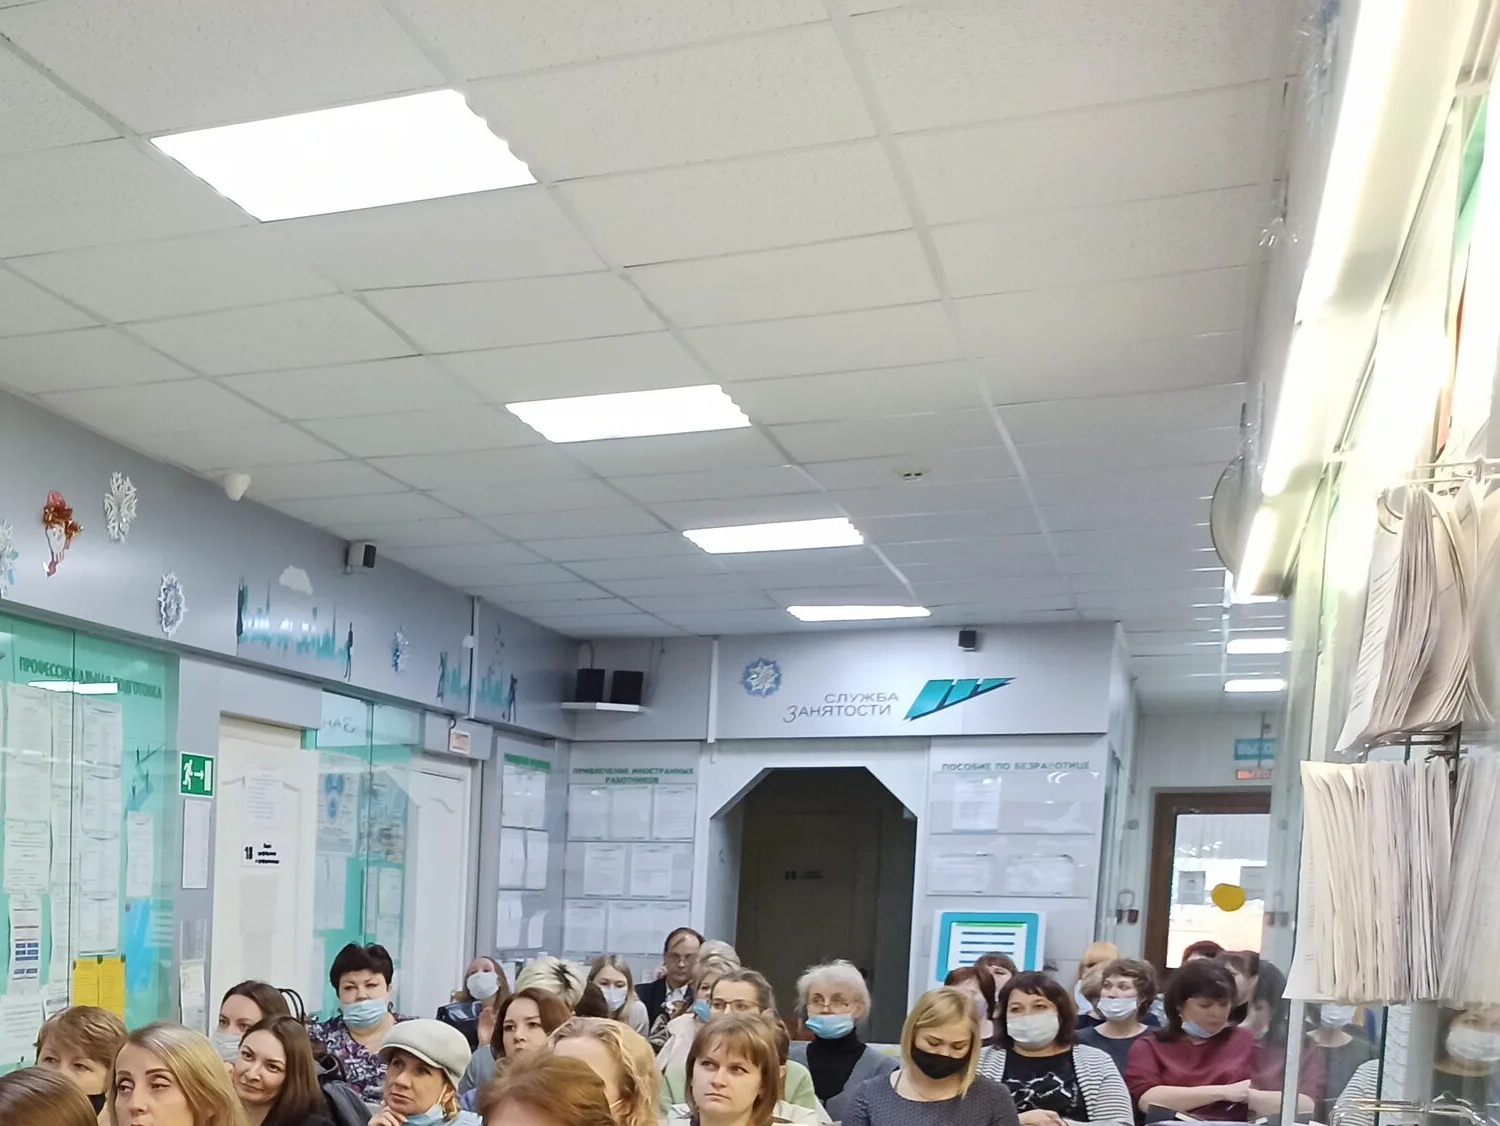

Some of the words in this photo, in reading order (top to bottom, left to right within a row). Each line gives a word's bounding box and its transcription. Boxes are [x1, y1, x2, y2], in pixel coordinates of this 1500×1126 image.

[824, 691, 900, 704] СЛУЖБА
[782, 704, 892, 723] ЗАНЯТОСТИ
[1014, 760, 1091, 771] БЕЗРАОТИЦЕ
